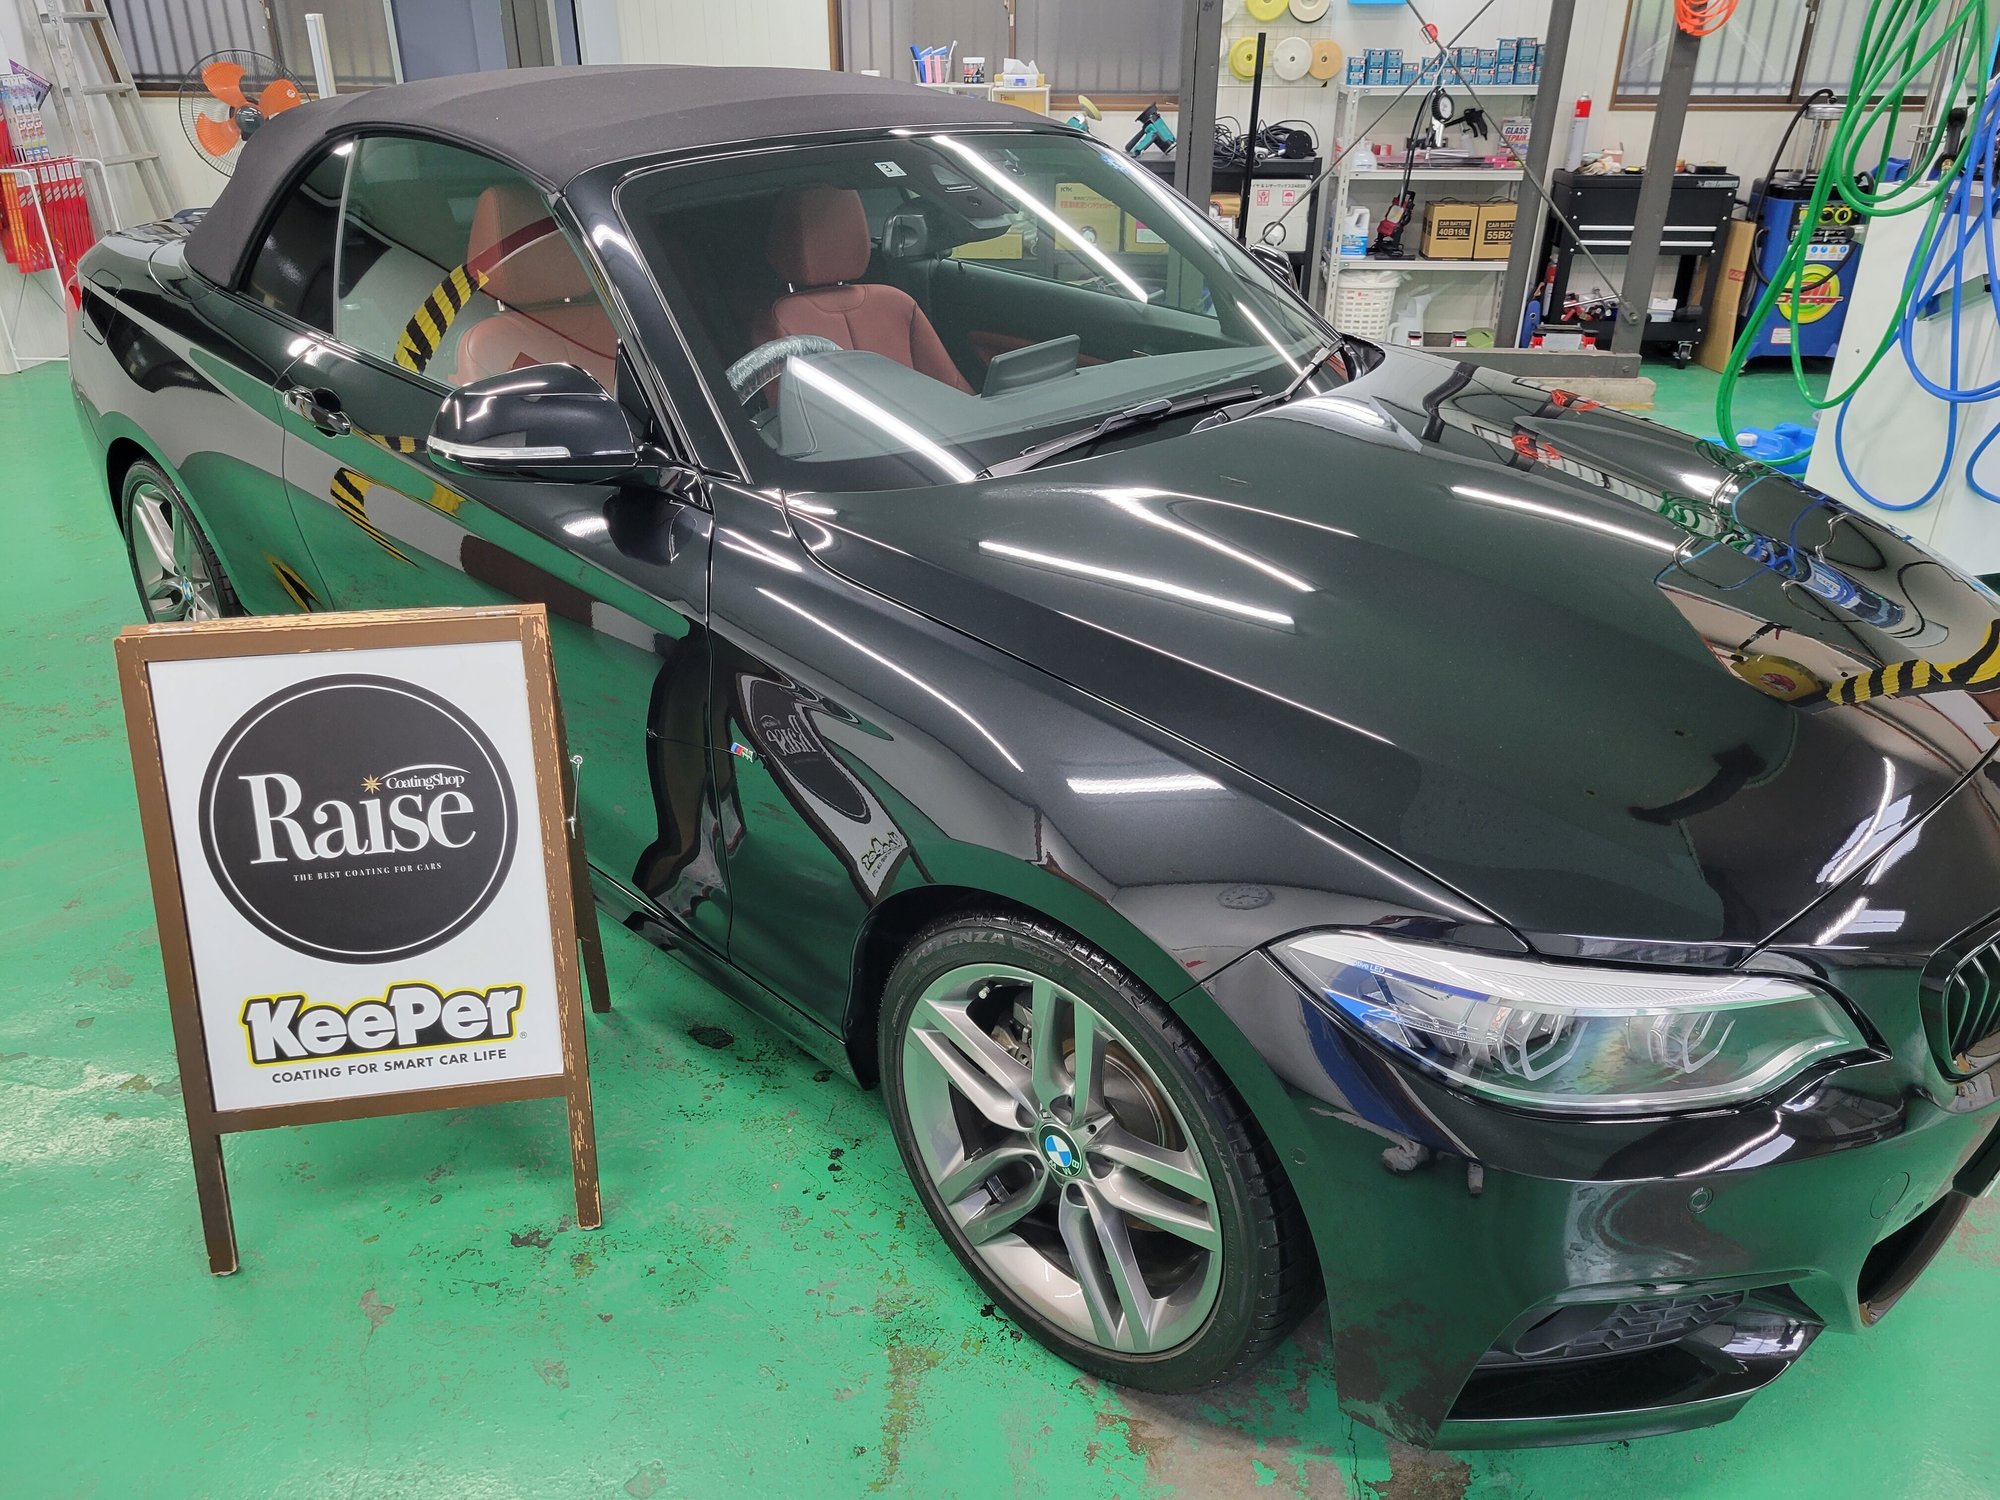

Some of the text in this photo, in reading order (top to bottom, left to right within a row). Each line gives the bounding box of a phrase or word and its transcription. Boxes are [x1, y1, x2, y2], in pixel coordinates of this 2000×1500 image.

[1505, 127, 1529, 135] GLASS
[1438, 228, 1469, 236] 40B19L
[237, 773, 477, 865] Raise
[293, 862, 442, 883] THE BEST COATING FOR CARS
[1369, 964, 1385, 974] LED
[243, 984, 523, 1065] KeePer
[272, 1048, 507, 1084] COATING FOR SMART CAR LIFE
